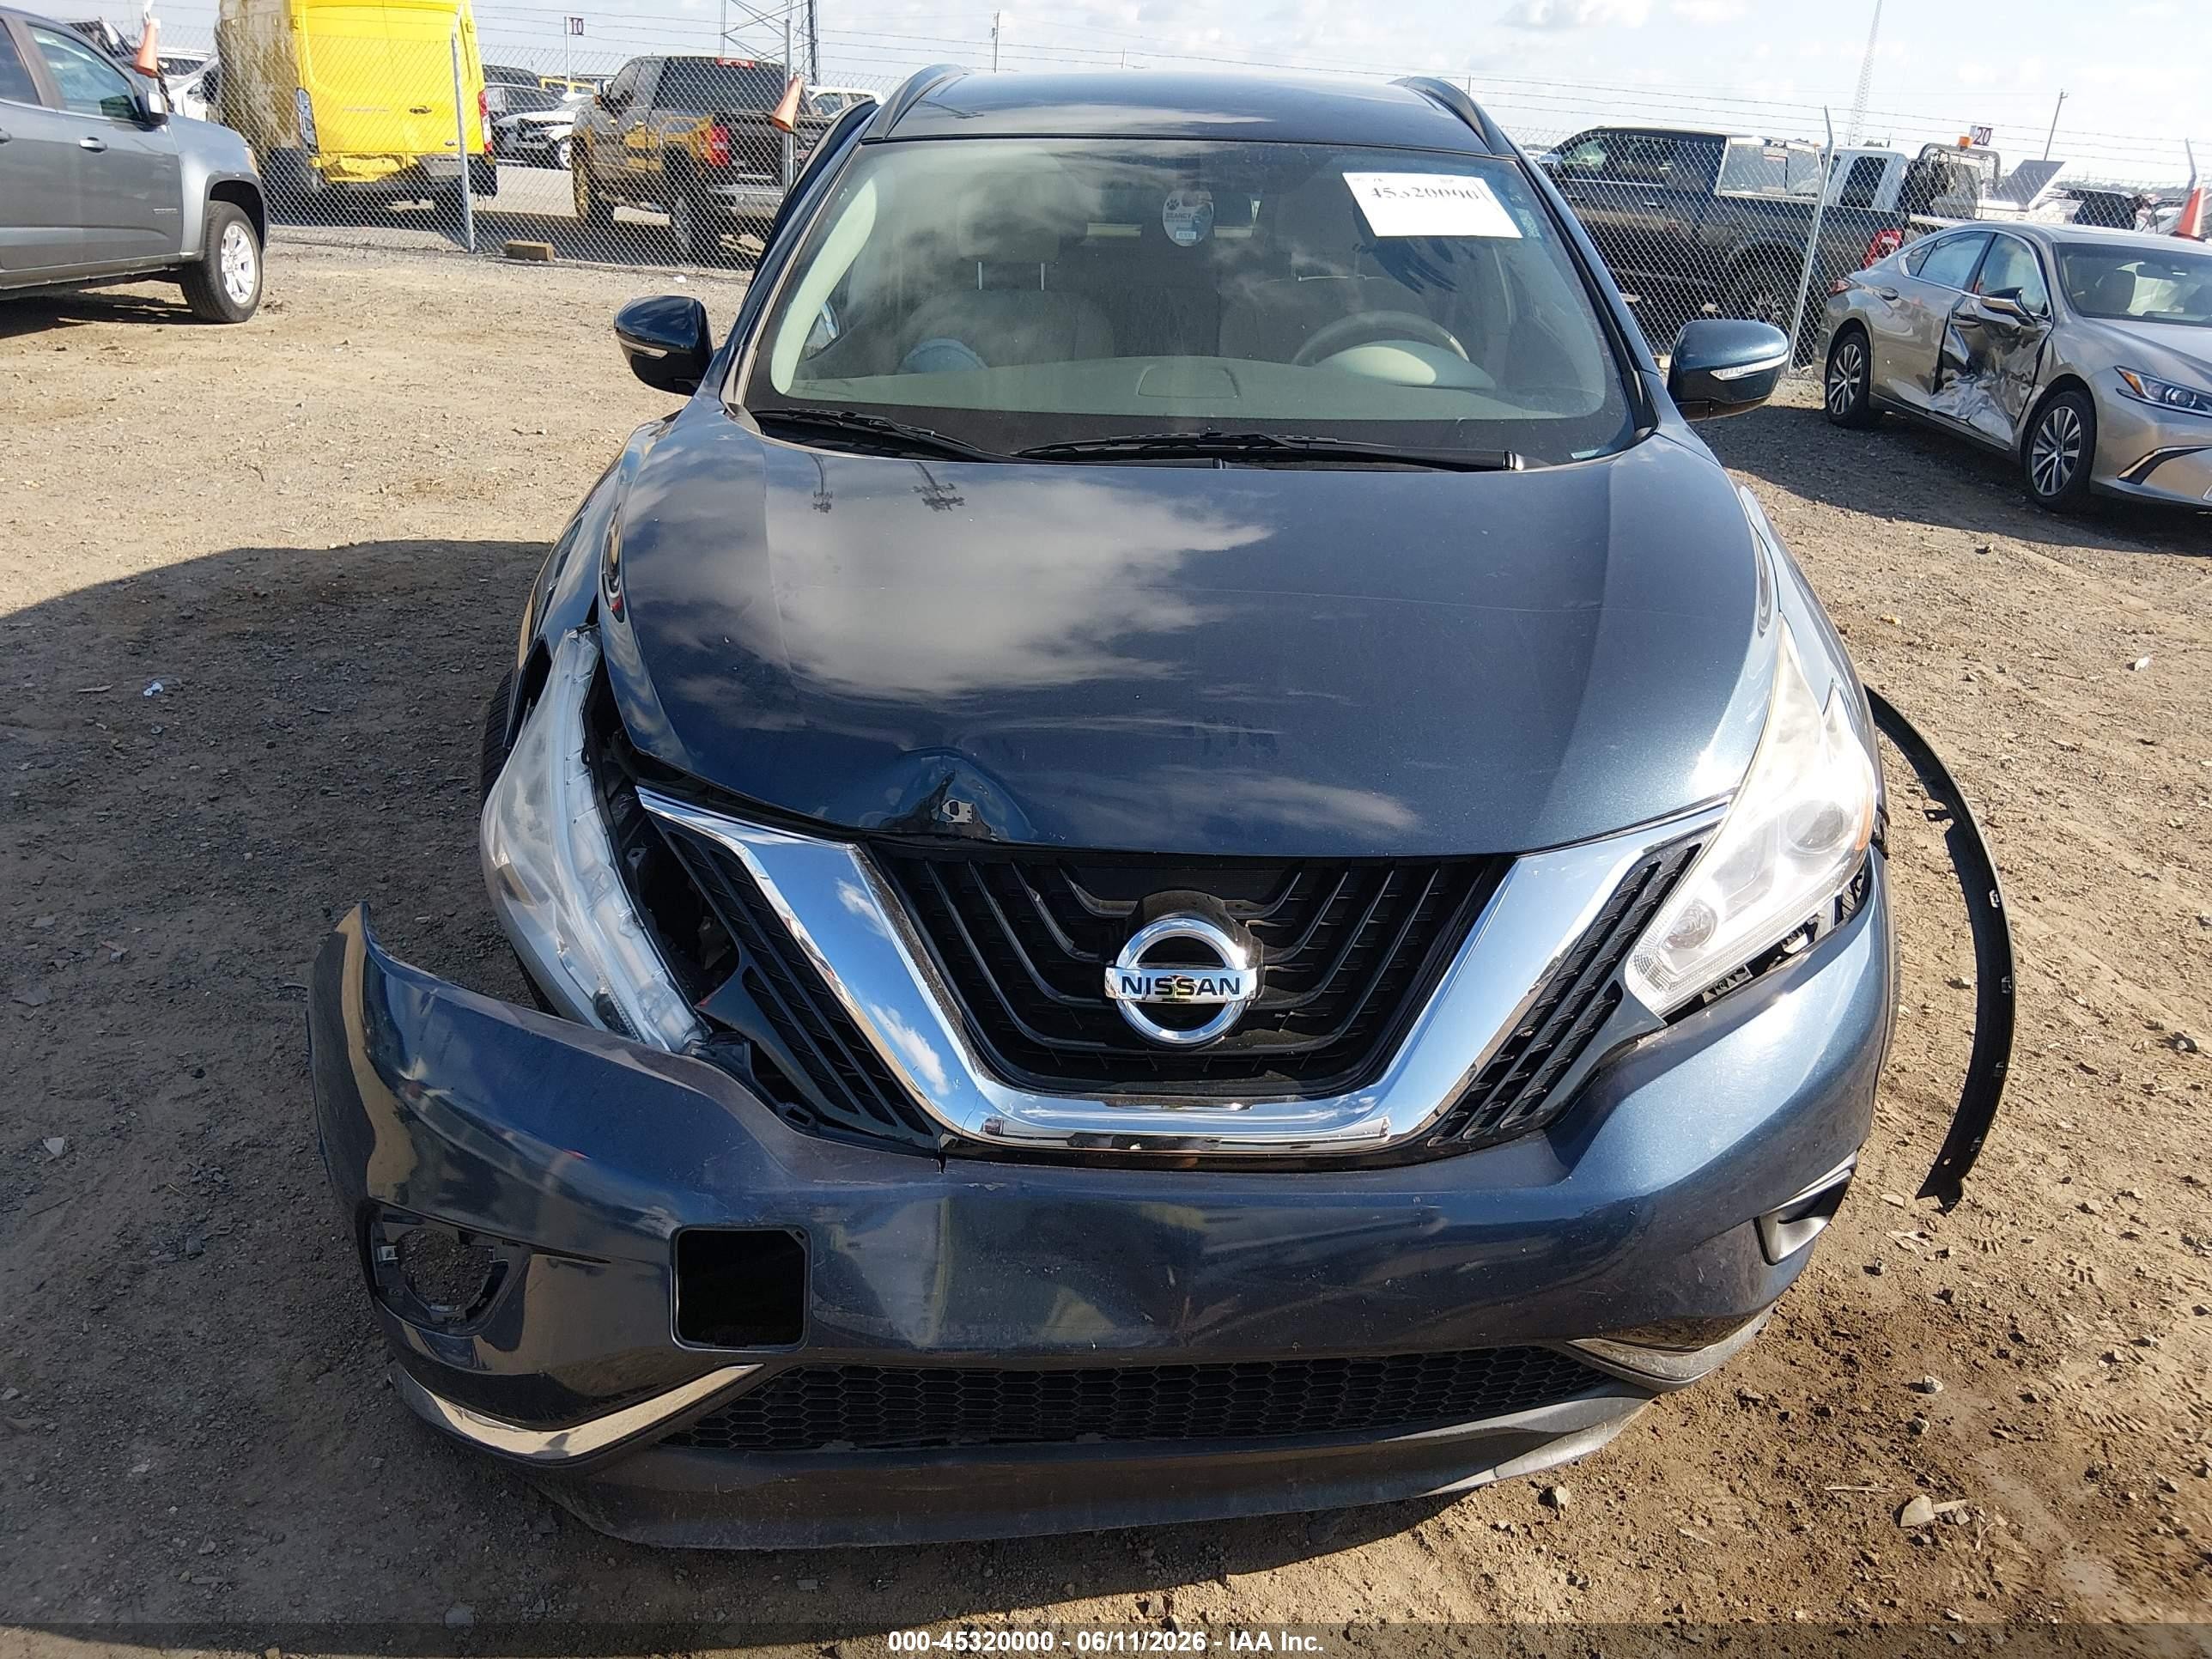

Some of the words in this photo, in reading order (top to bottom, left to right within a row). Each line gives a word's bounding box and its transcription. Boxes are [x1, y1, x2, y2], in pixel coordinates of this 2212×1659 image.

[569, 17, 585, 36] 10
[1972, 126, 1993, 147] 20
[1121, 975, 1241, 997] NISSAN
